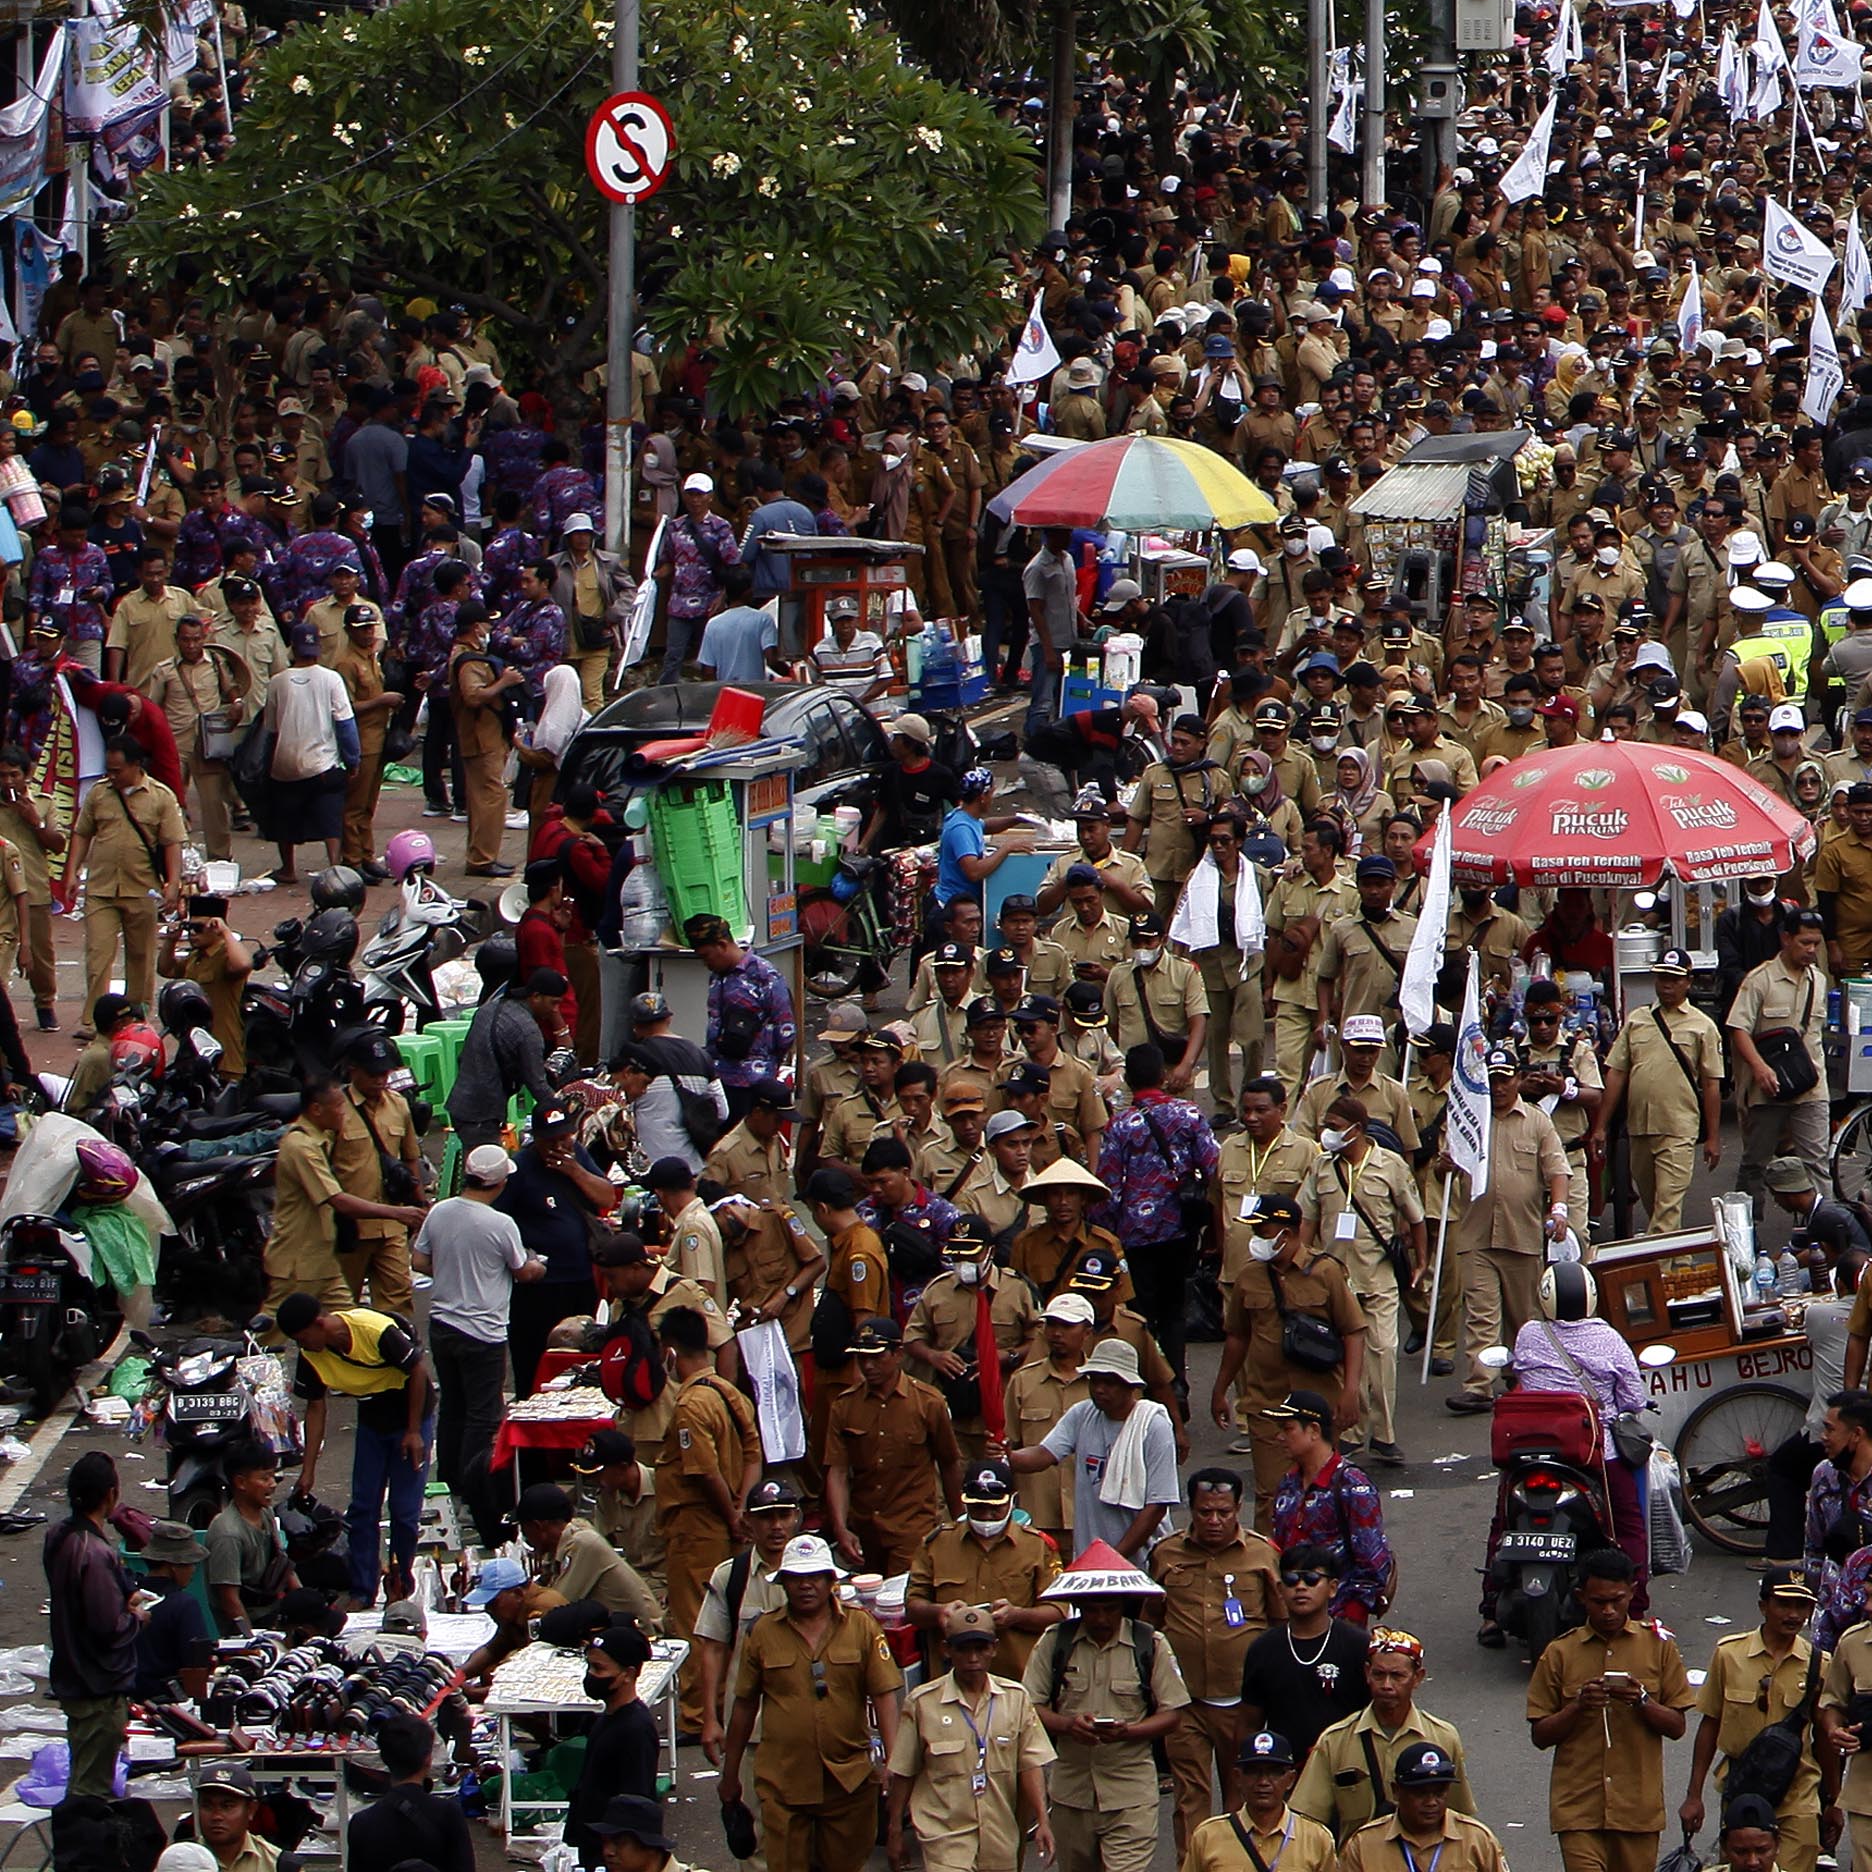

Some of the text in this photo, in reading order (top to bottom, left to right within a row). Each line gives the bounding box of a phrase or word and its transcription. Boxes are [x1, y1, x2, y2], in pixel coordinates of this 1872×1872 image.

[43, 782, 74, 882] JABAN
[1713, 846, 1734, 859] Teh
[1734, 840, 1773, 857] Terbaik
[1566, 856, 1591, 867] Teh
[1593, 855, 1643, 867] Terbaik
[1534, 870, 1642, 885] ada di Pucuknya!
[1641, 1345, 1814, 1396] AHU GEJRO
[177, 1397, 185, 1408] B
[188, 1396, 215, 1408] 3139
[1503, 1535, 1512, 1547] B
[1517, 1535, 1544, 1548] 3140
